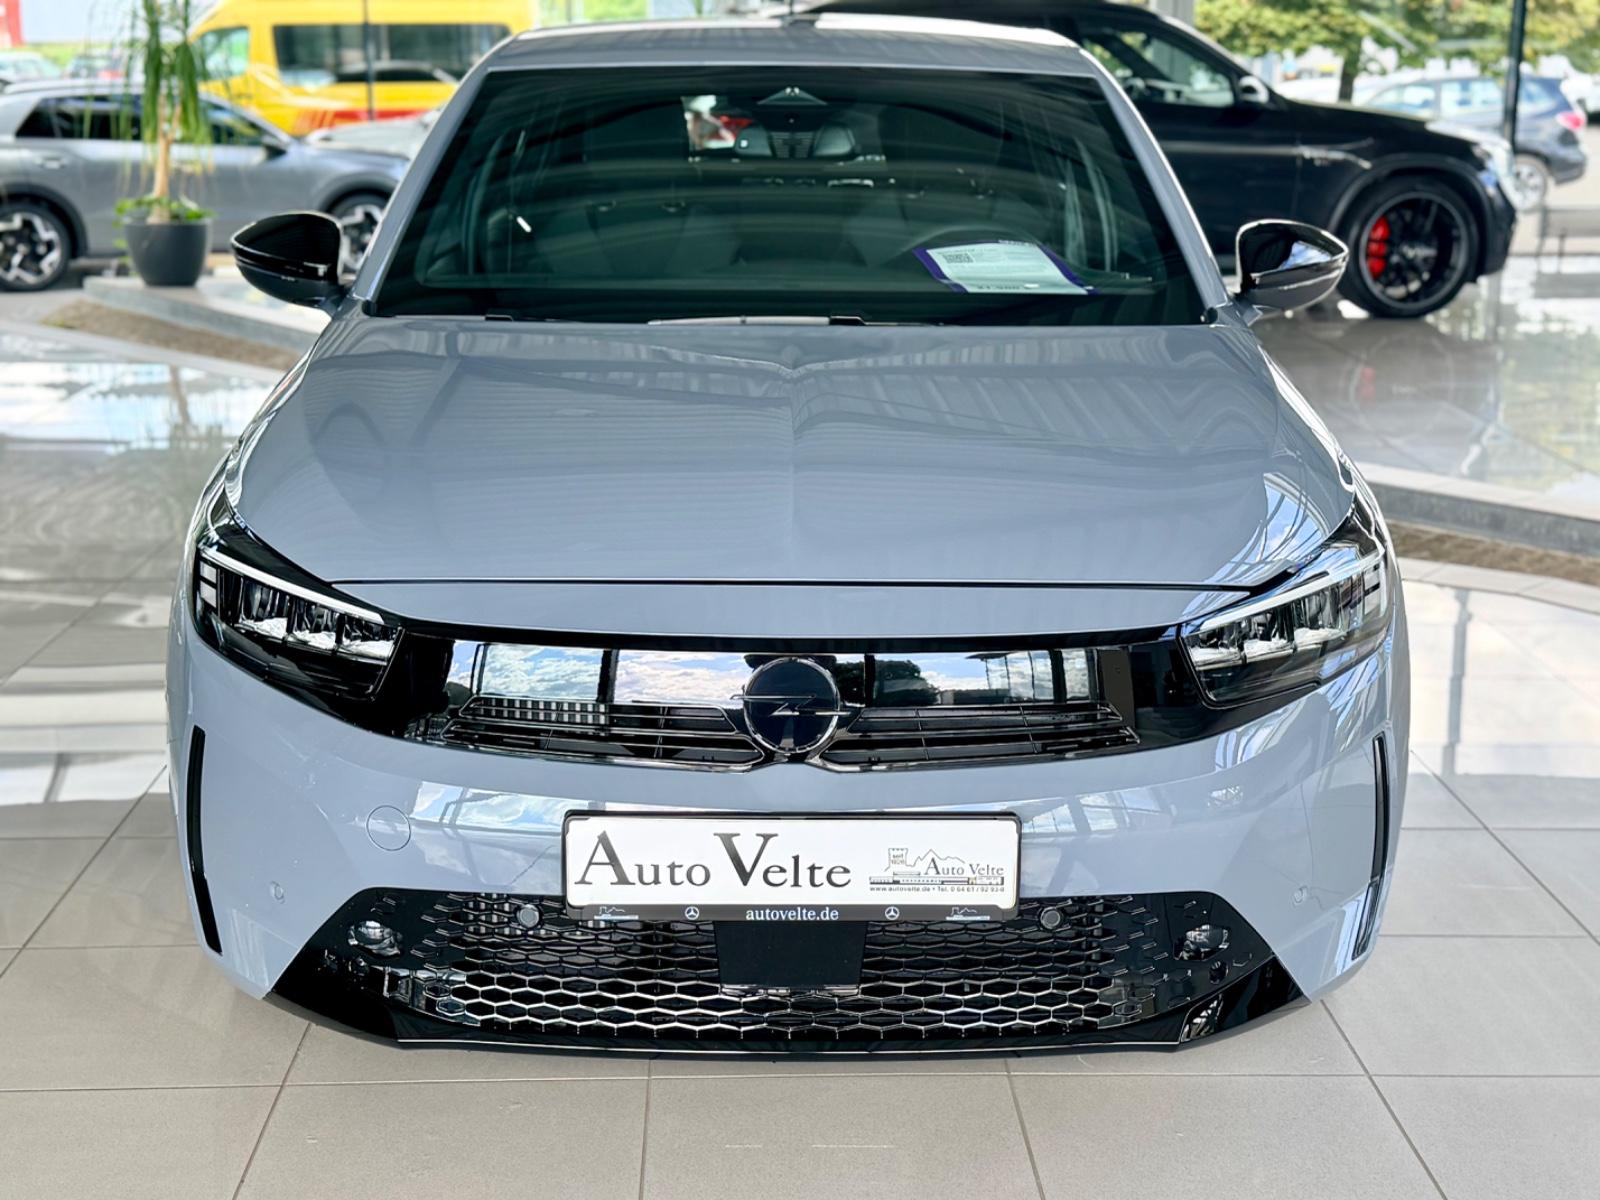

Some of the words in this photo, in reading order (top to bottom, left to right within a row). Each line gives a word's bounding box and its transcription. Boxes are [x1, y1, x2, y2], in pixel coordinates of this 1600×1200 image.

[574, 830, 711, 886] Auto
[714, 832, 852, 888] Velte
[924, 858, 965, 876] Auto
[969, 864, 1004, 876] Velte
[745, 907, 839, 920] autovelte.de
